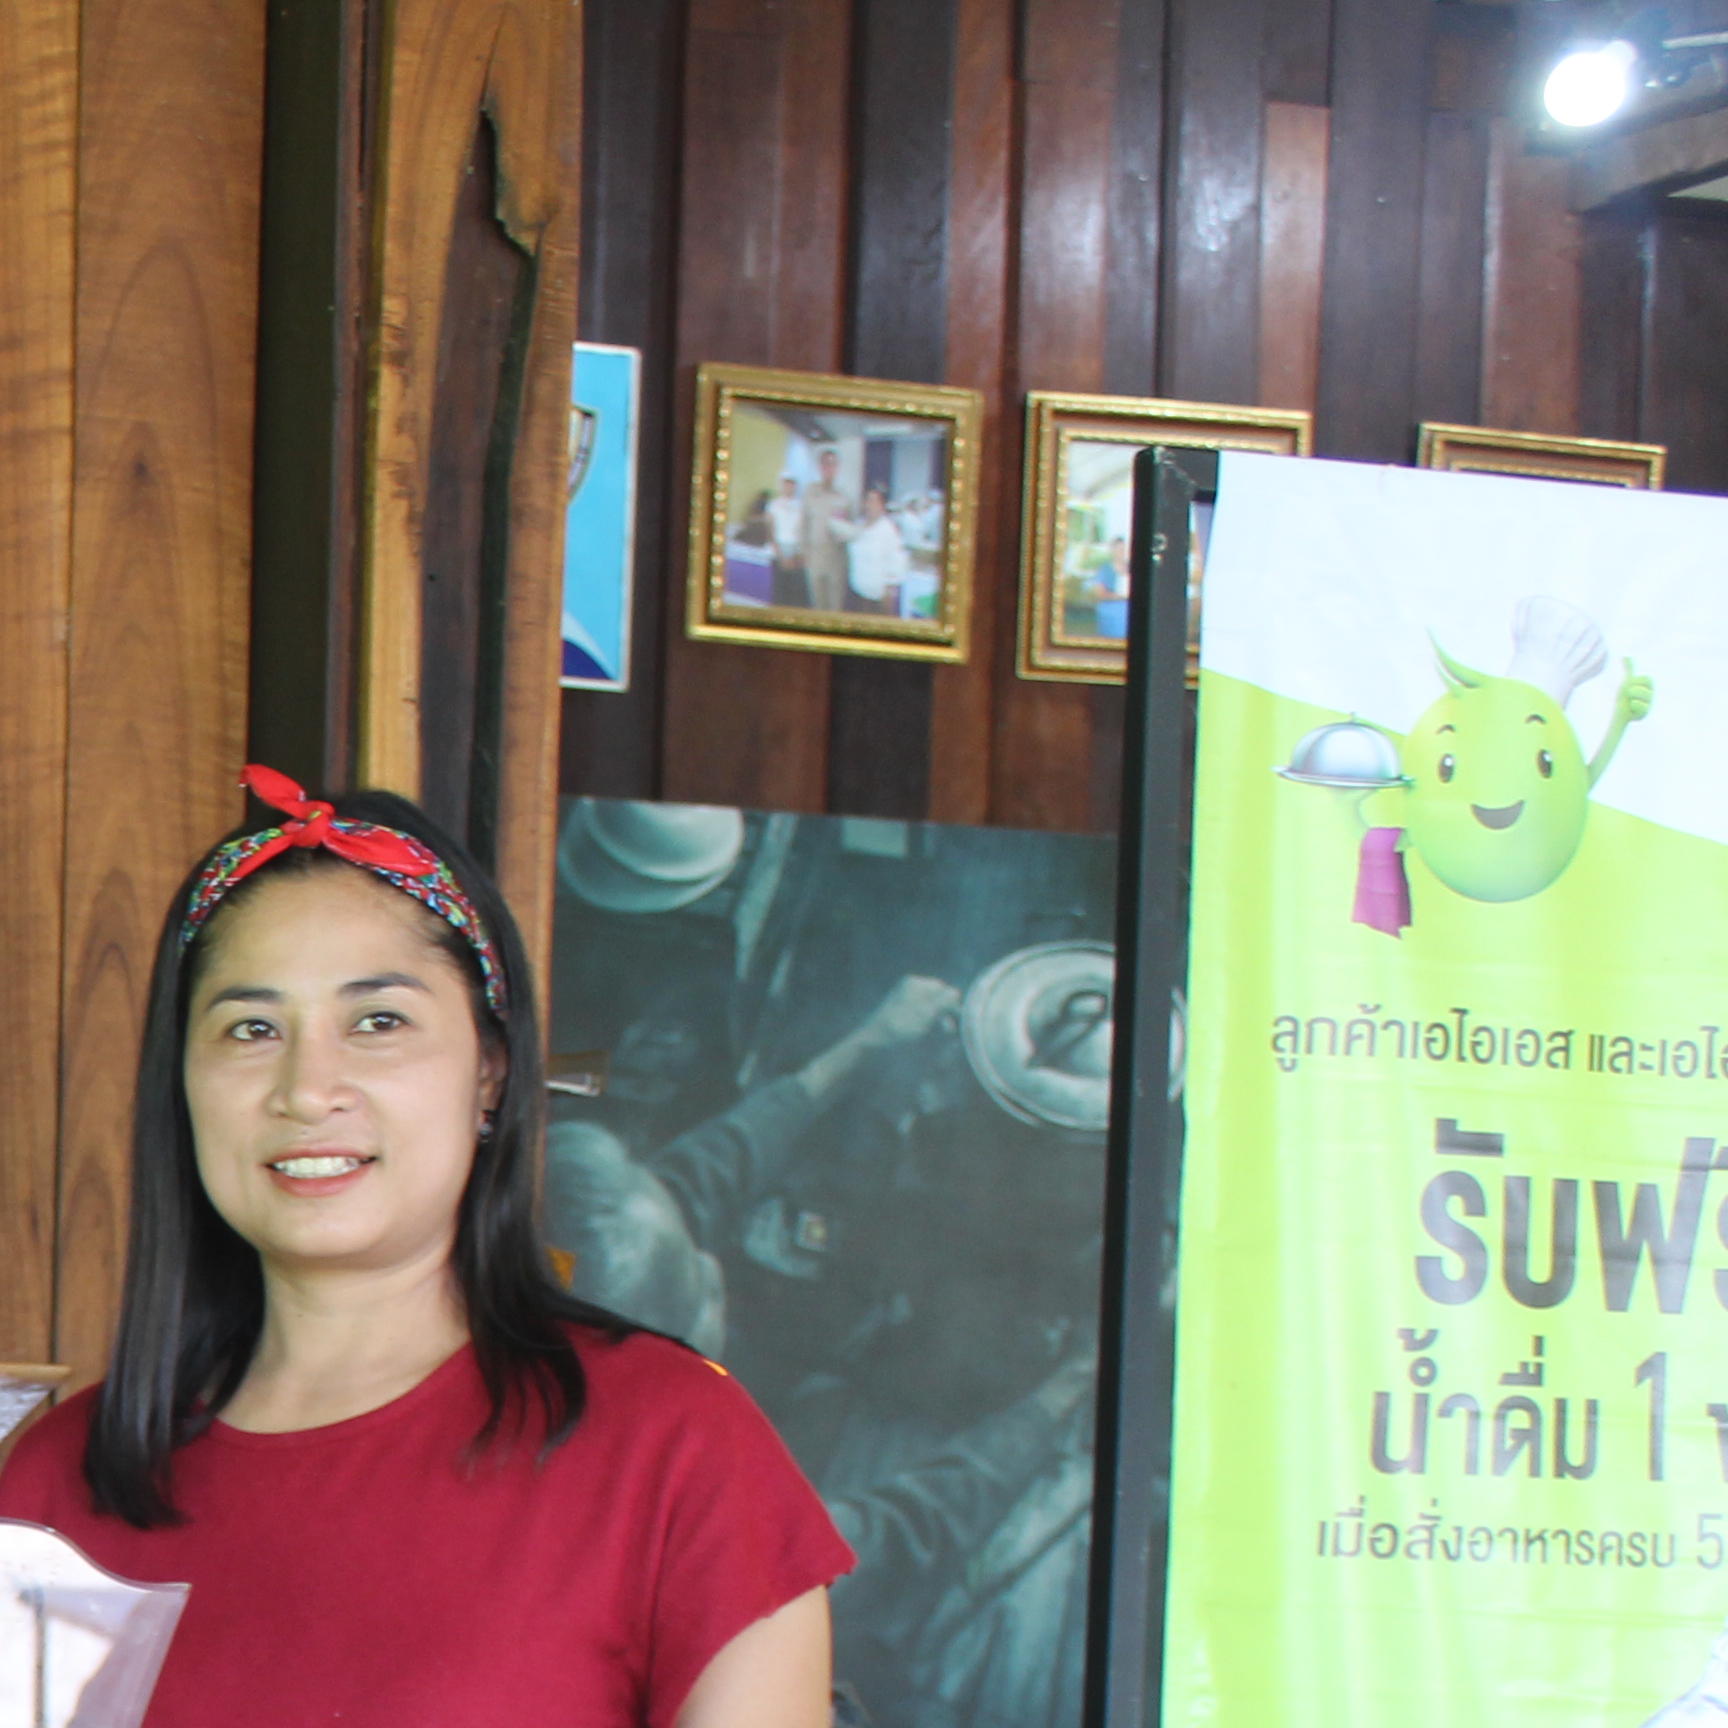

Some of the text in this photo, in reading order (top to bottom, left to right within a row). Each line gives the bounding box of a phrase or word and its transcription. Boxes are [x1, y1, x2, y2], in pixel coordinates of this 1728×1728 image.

[1271, 1003, 1728, 1079] ลูกค้าเอไอเอส และเอไ
[1414, 1117, 1728, 1314] รับฟ
[1369, 1328, 1599, 1479] น้ำดื่ม
[1634, 1352, 1666, 1482] 1
[1317, 1495, 1675, 1567] เมื่อสั่งอาหารครบ
